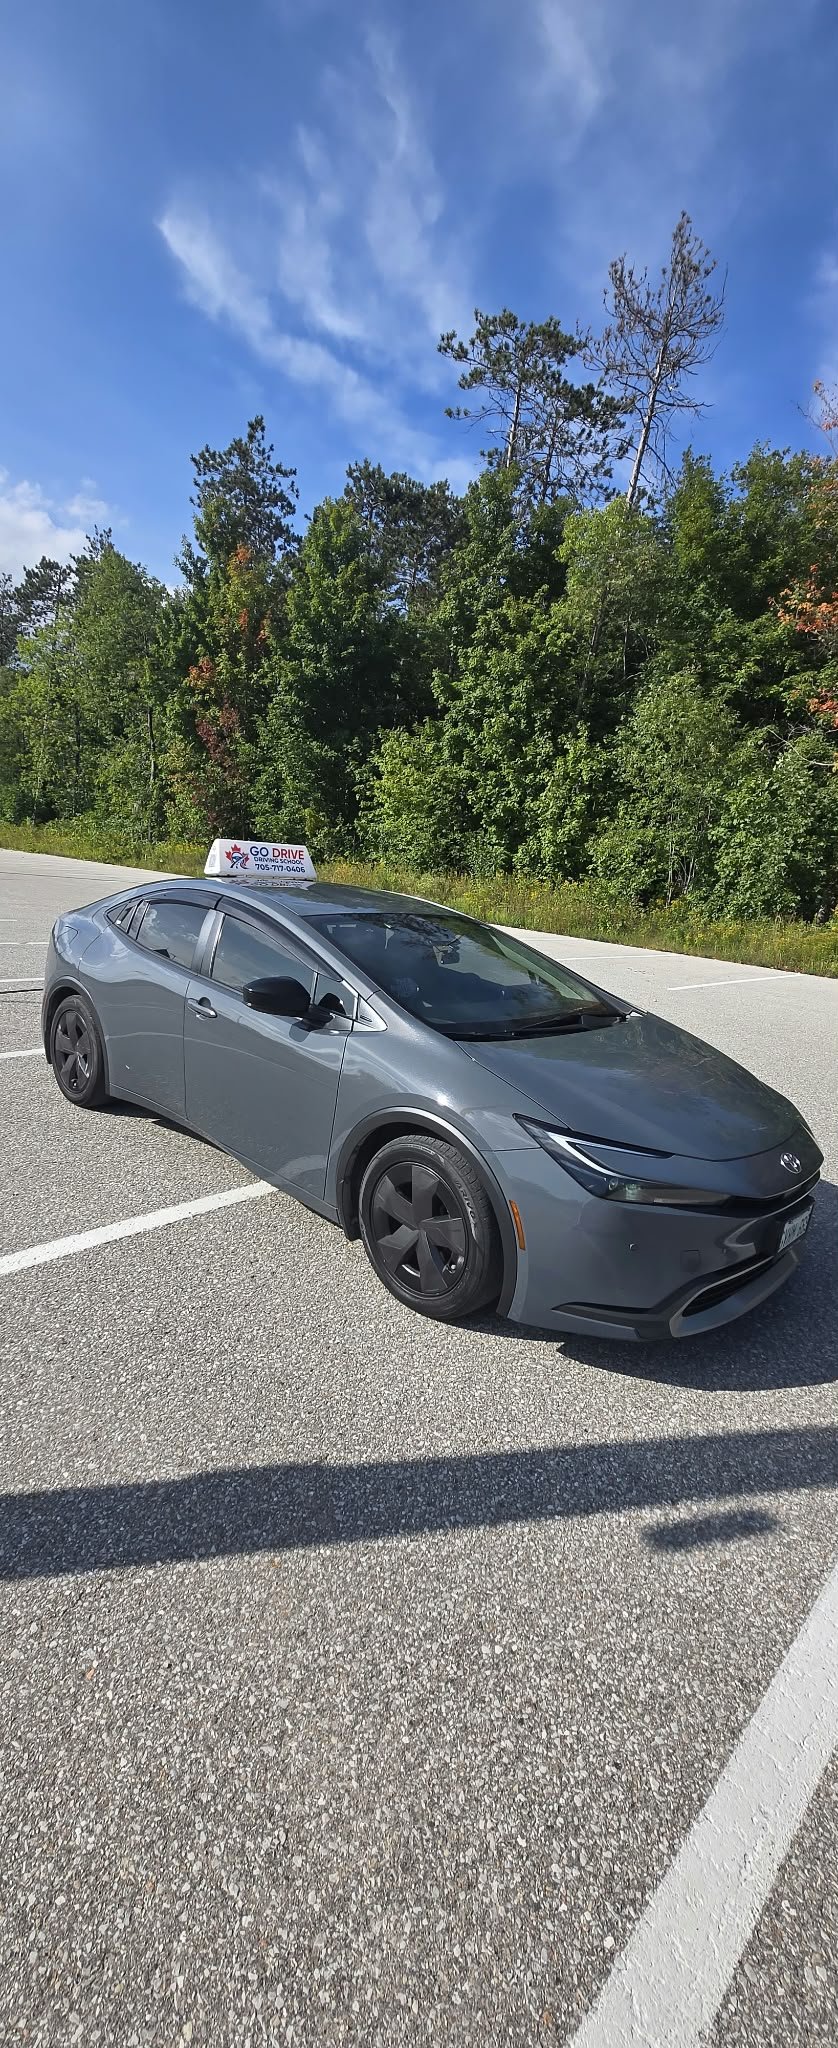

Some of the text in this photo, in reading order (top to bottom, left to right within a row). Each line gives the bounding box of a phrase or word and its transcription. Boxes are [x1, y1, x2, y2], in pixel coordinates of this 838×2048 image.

[250, 846, 304, 860] GO DRIVE
[254, 864, 306, 873] 705-717-0406
